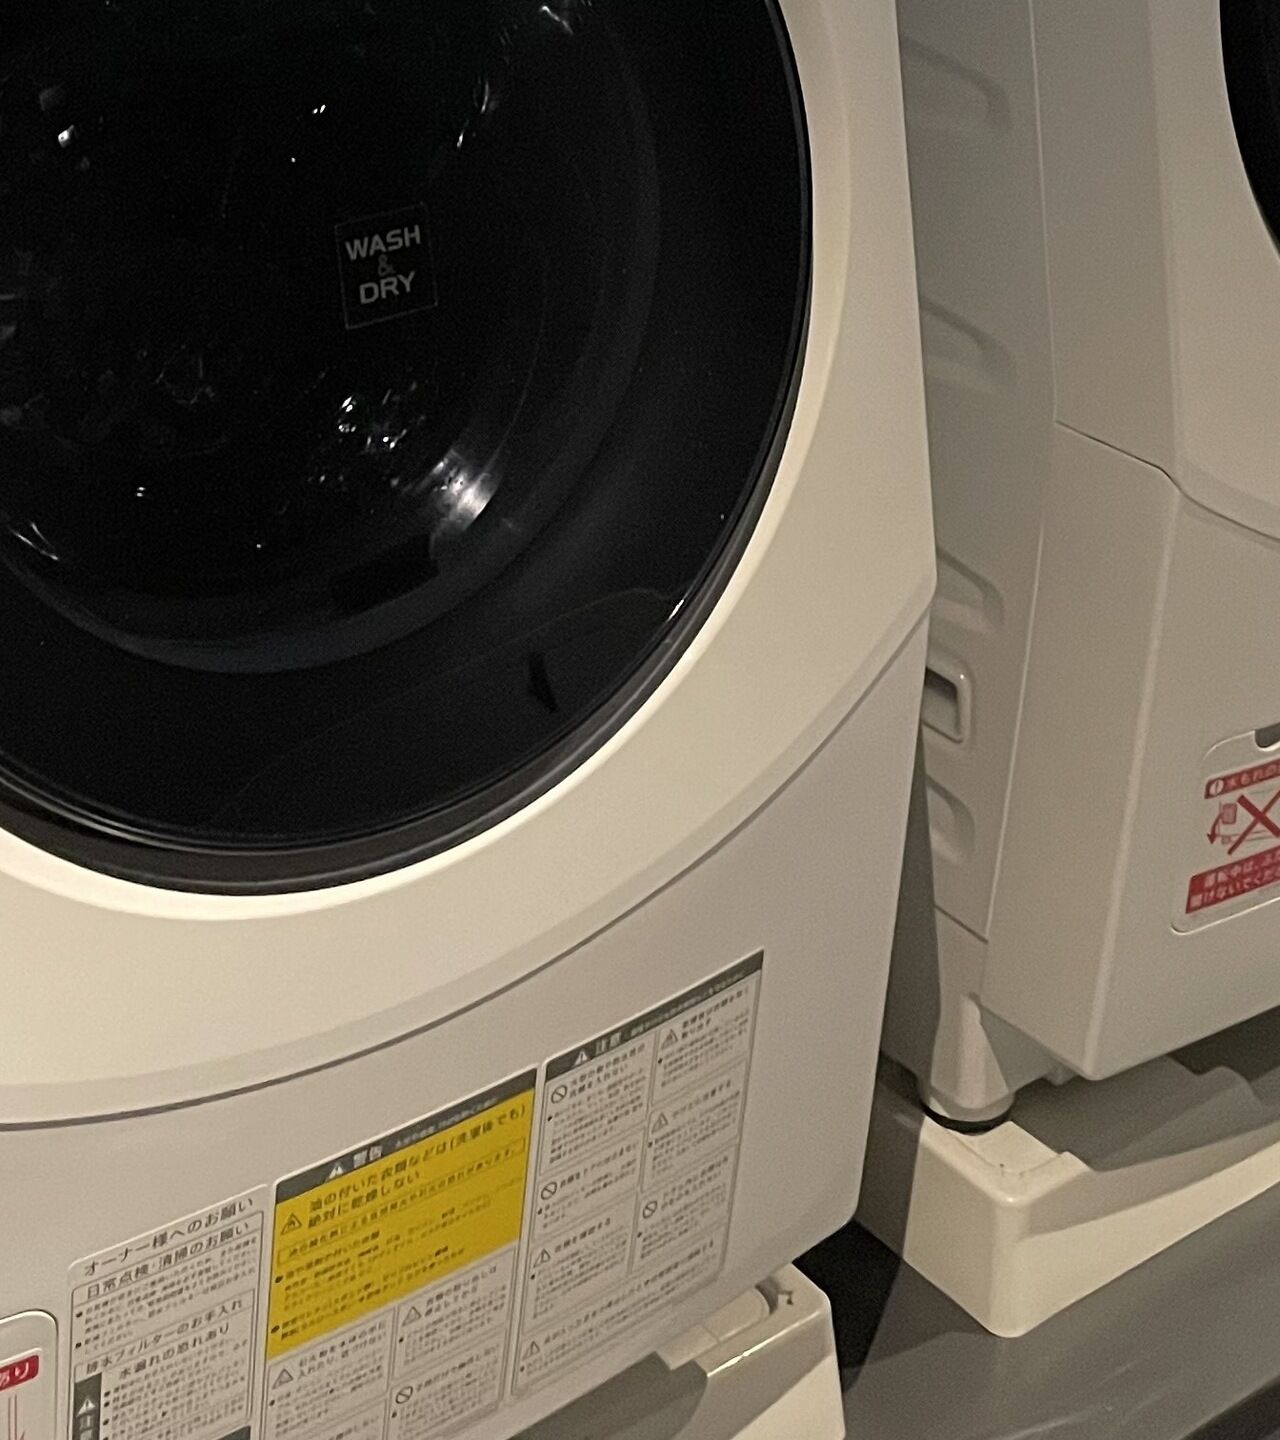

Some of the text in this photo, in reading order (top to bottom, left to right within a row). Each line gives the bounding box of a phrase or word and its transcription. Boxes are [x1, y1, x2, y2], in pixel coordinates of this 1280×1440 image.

[344, 224, 421, 262] WASH
[358, 270, 416, 305] DRY
[83, 1197, 254, 1277] オーナー様へのお願い
